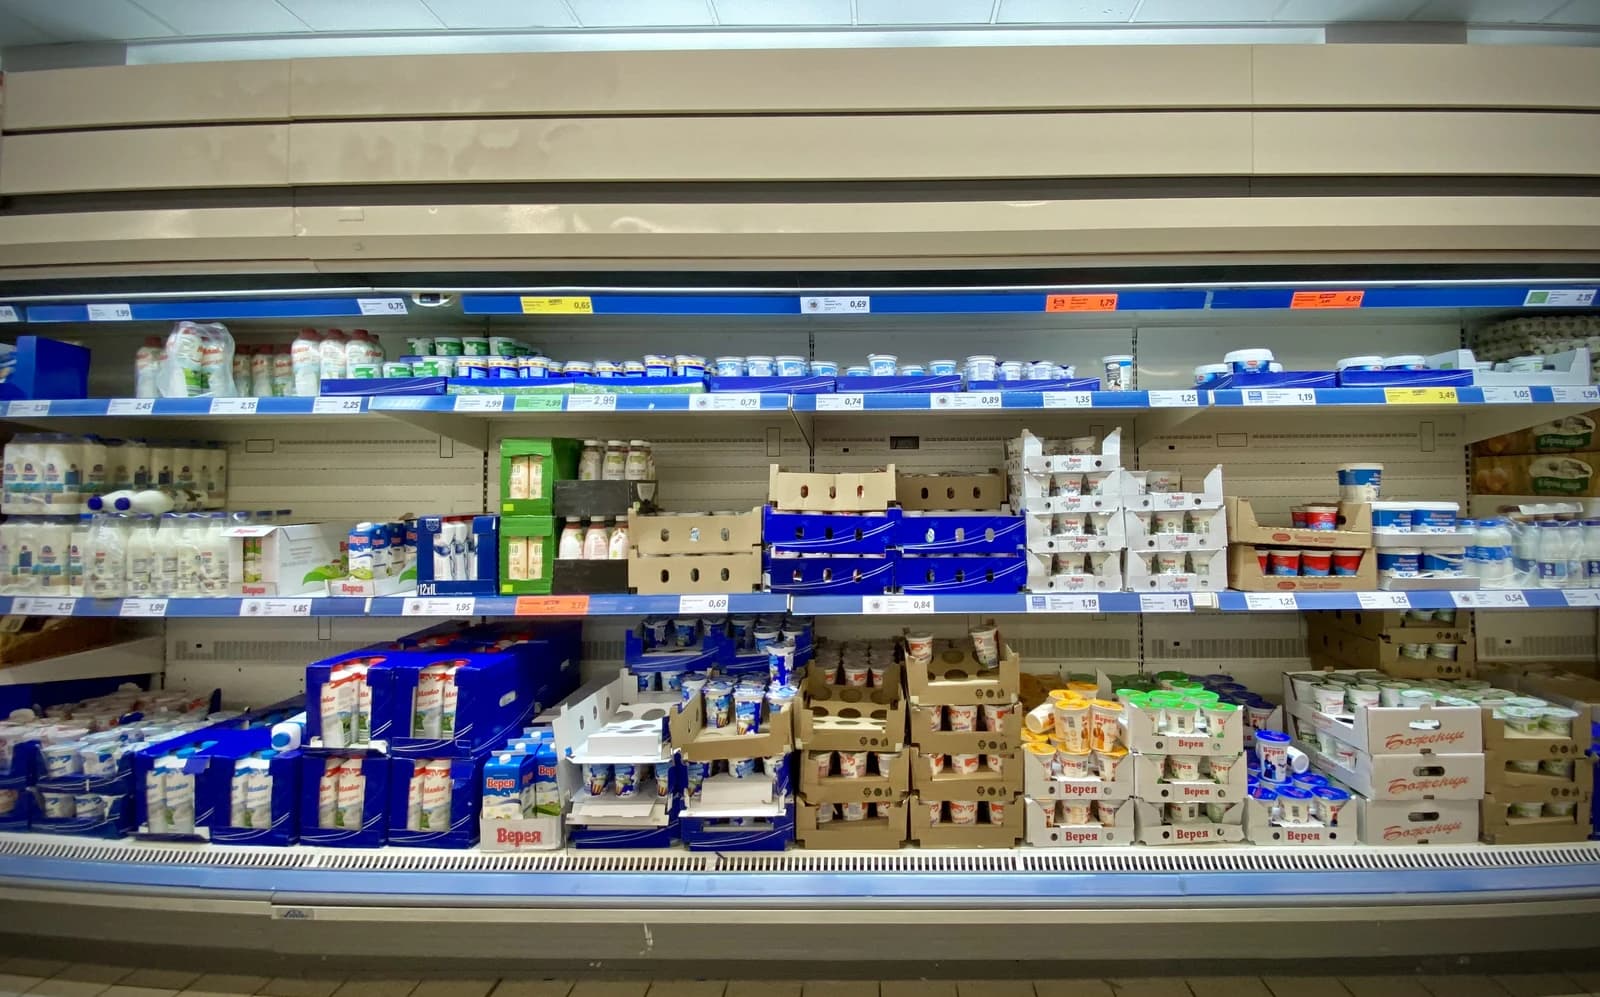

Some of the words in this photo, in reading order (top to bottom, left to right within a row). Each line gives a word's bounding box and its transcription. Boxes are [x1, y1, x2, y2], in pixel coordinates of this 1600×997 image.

[388, 302, 405, 310] 0,75
[574, 301, 591, 310] 0,65
[850, 300, 867, 309] 0,69
[1100, 299, 1116, 307] 1,79
[1180, 394, 1196, 403] 1,25
[1298, 393, 1313, 402] 1,19
[1438, 391, 1456, 400] 3,49
[1512, 390, 1529, 398] 1,05
[593, 396, 615, 405] 2,99
[740, 399, 757, 407] 0,79
[844, 398, 862, 406] 0,74
[981, 396, 1000, 404] 0,89
[1074, 395, 1090, 403] 1,35
[343, 401, 360, 409] 2,25
[485, 400, 502, 408] 2,99
[708, 599, 727, 608] 0,69
[1081, 600, 1097, 608] 1,19
[1172, 598, 1189, 608] 1,19
[1279, 598, 1295, 606] 1,25
[1391, 595, 1407, 604] 1,25
[456, 603, 472, 612] 1,95
[913, 601, 931, 610] 0,84
[1178, 739, 1205, 750] Верея
[1385, 730, 1465, 750] Боженци
[538, 765, 556, 778] Вер
[486, 778, 515, 791] Верея
[1388, 776, 1469, 795] Боженци
[1064, 784, 1098, 797] Верея
[1184, 787, 1211, 798] Верея
[1176, 829, 1210, 842] Верея
[1383, 822, 1462, 841] Боженци
[497, 827, 542, 848] Верея
[1065, 831, 1098, 844] Верея
[1287, 830, 1321, 843] Верея
